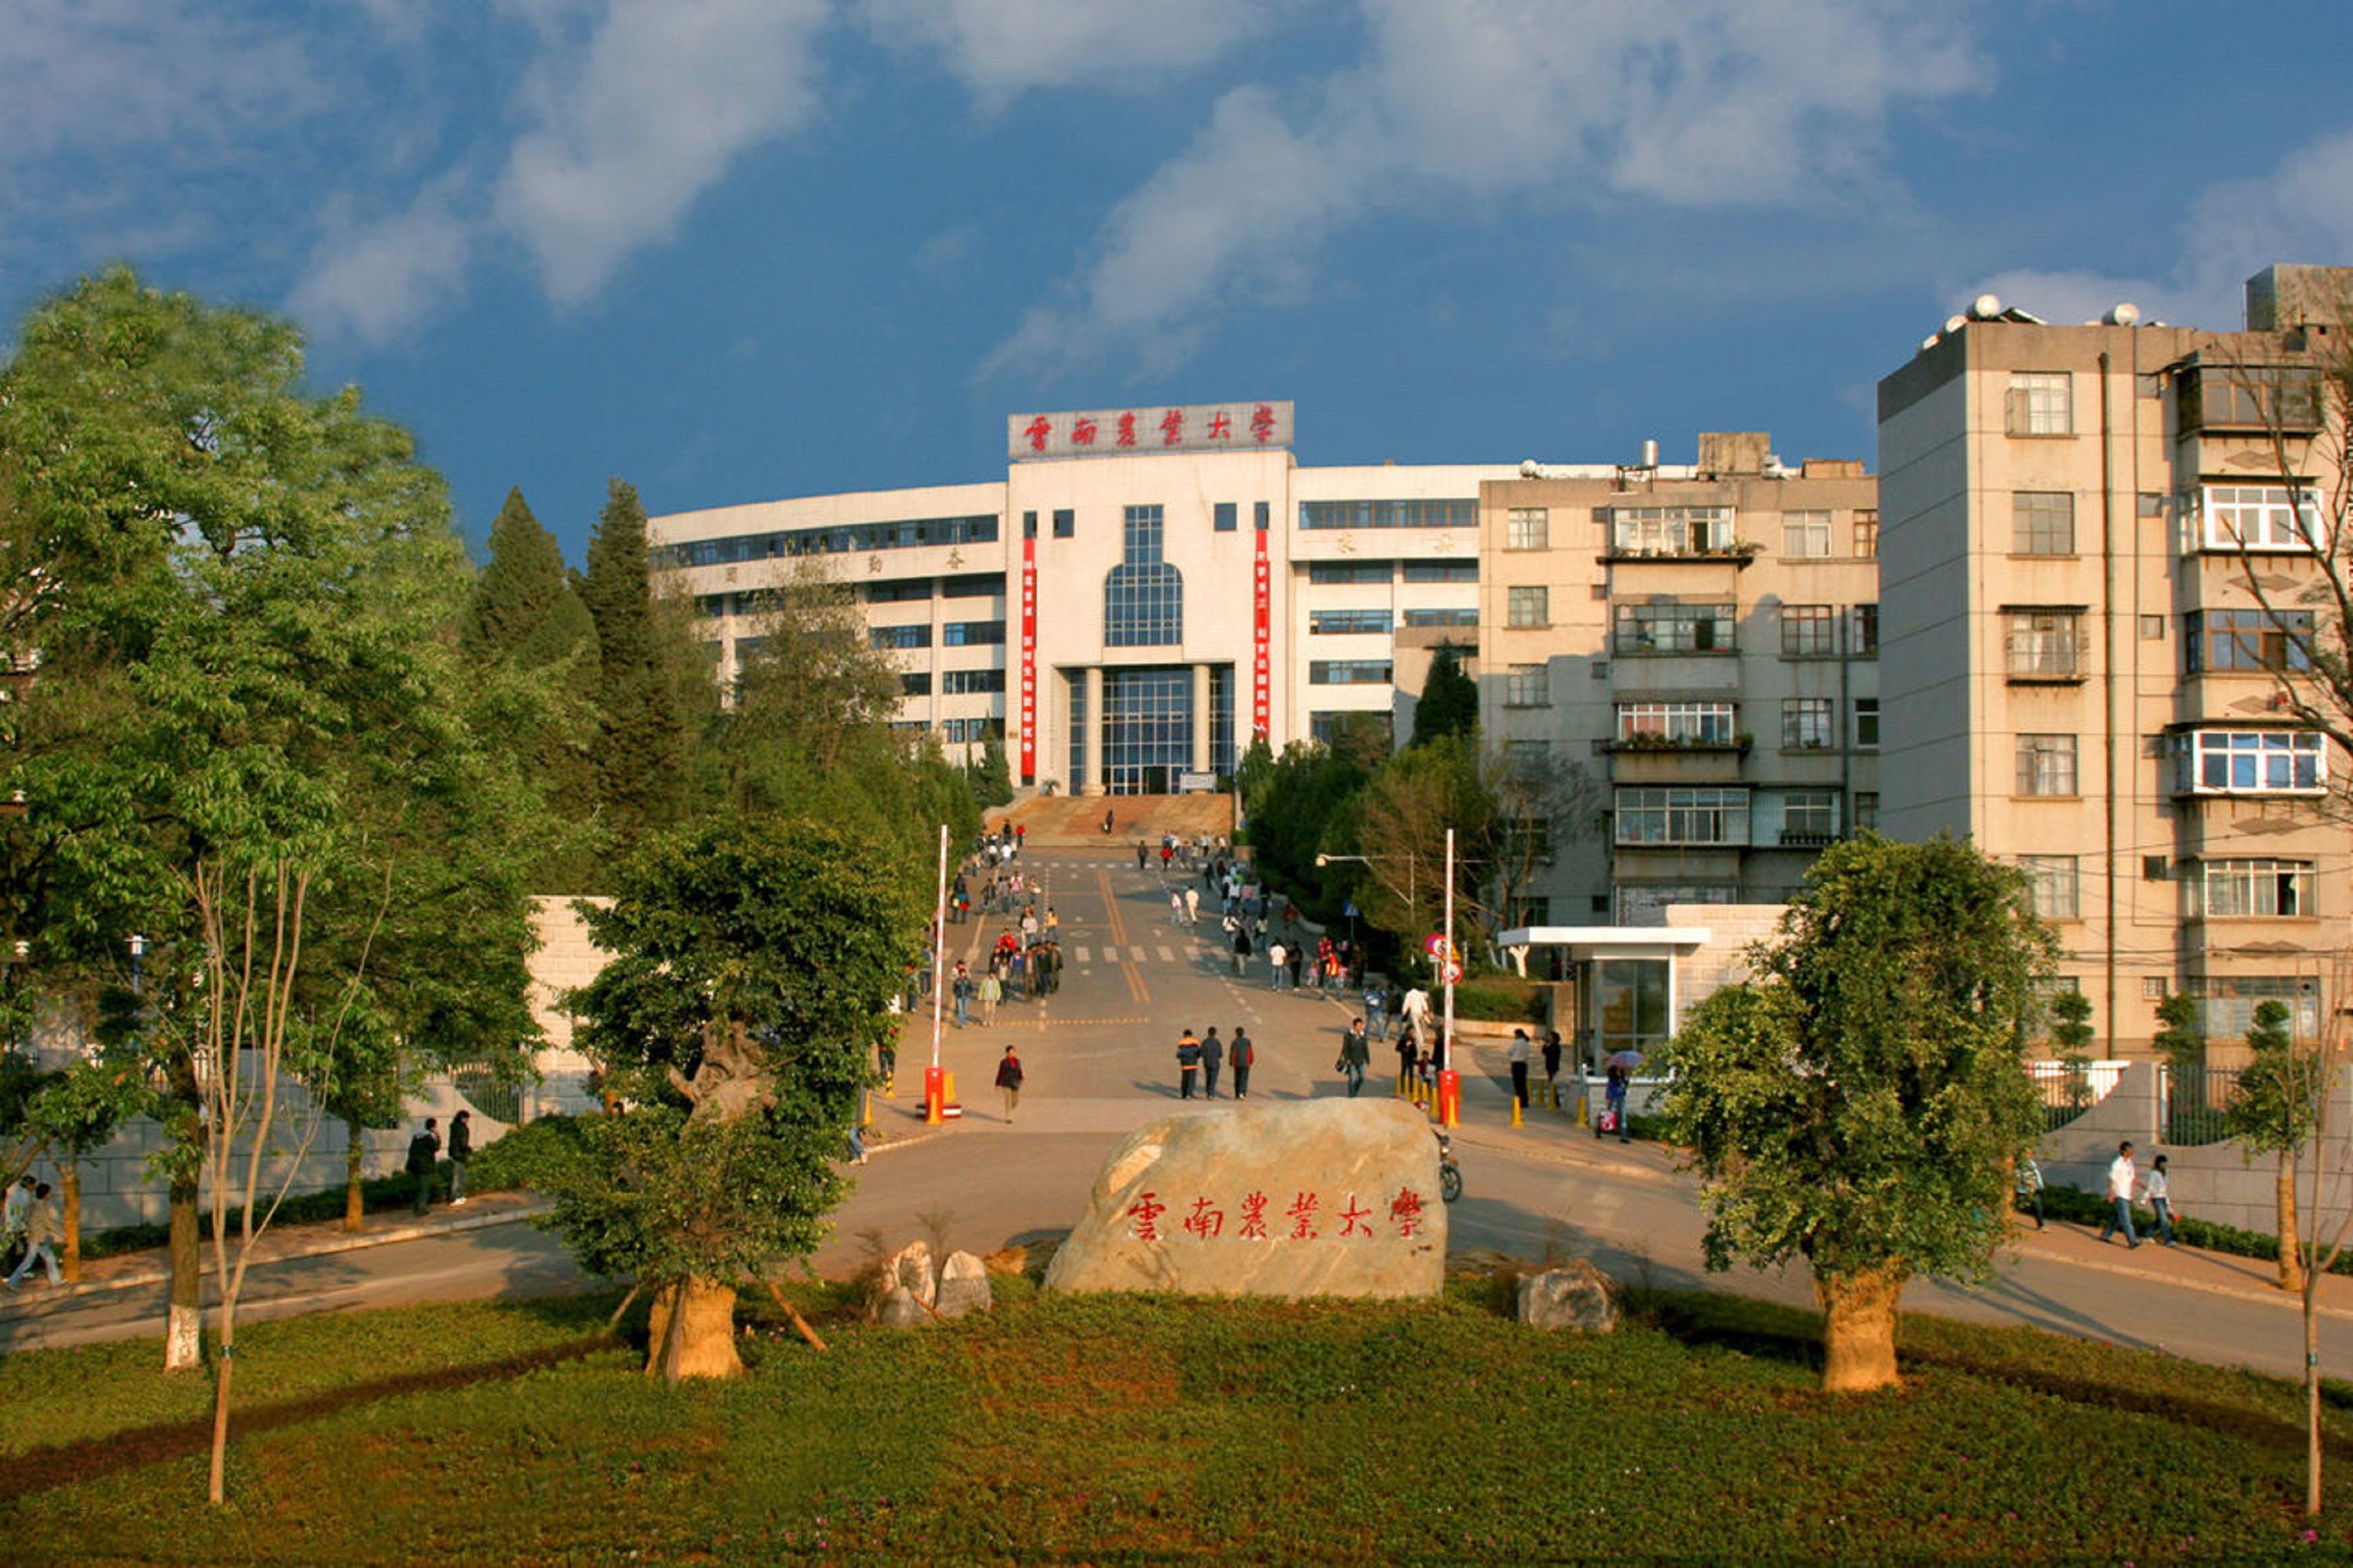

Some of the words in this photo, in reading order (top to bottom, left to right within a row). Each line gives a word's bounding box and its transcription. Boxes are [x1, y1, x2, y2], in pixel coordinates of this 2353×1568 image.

[1127, 1186, 1424, 1241] 雲南農業大學
